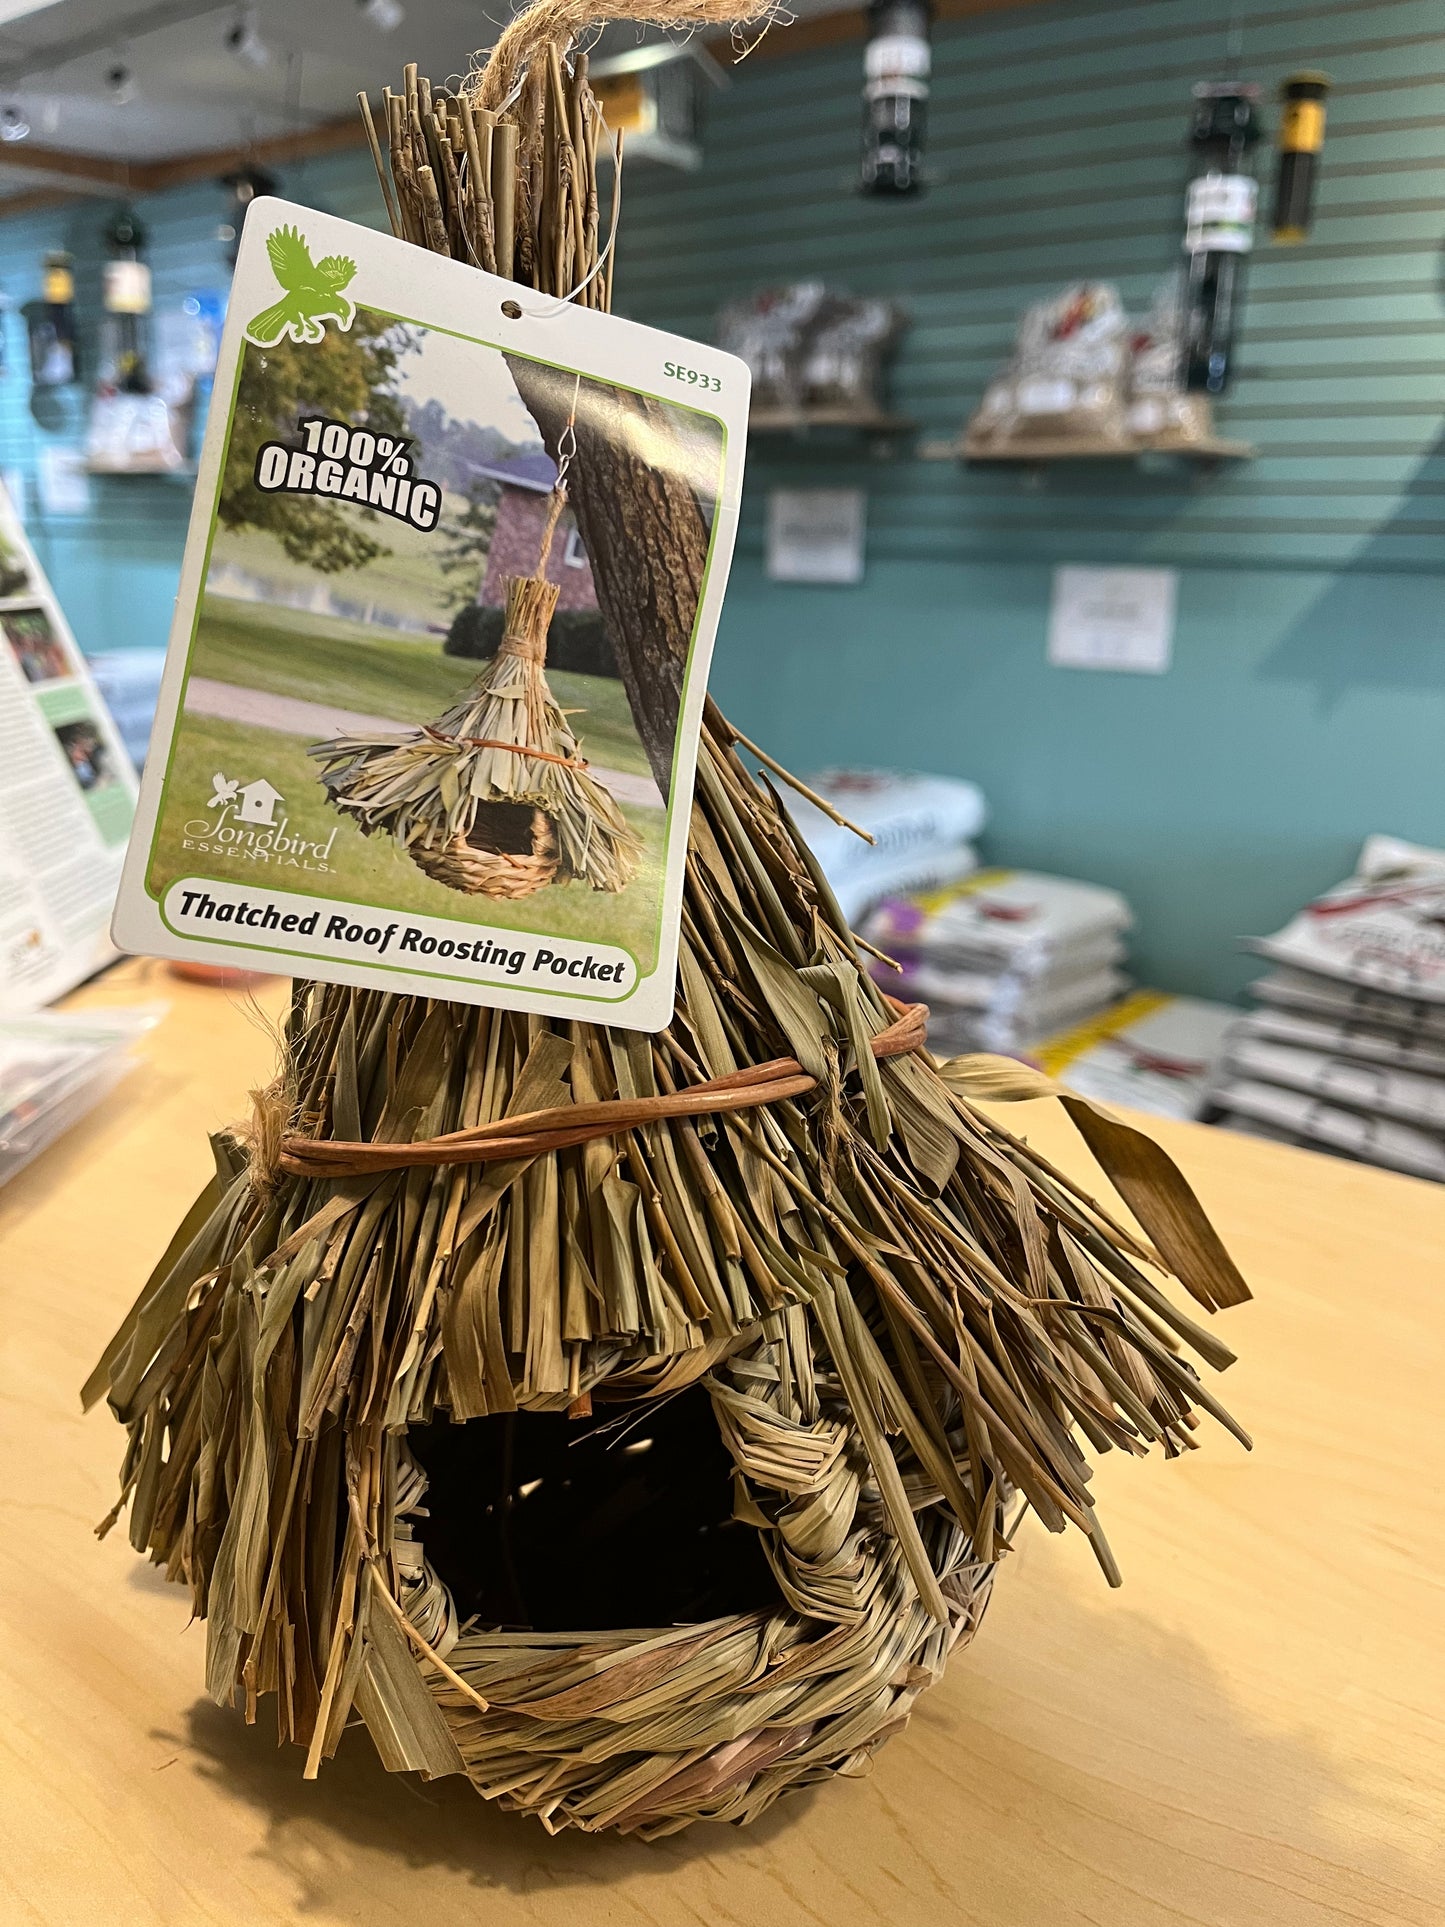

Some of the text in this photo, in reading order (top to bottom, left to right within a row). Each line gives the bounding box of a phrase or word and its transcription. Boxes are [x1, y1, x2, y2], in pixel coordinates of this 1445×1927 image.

[664, 361, 722, 393] SE933
[303, 421, 410, 476] 100%
[260, 447, 440, 528] ORGANIC
[184, 804, 338, 859] Songbird
[180, 892, 625, 983] Thatched Roof Roosting Pocket
